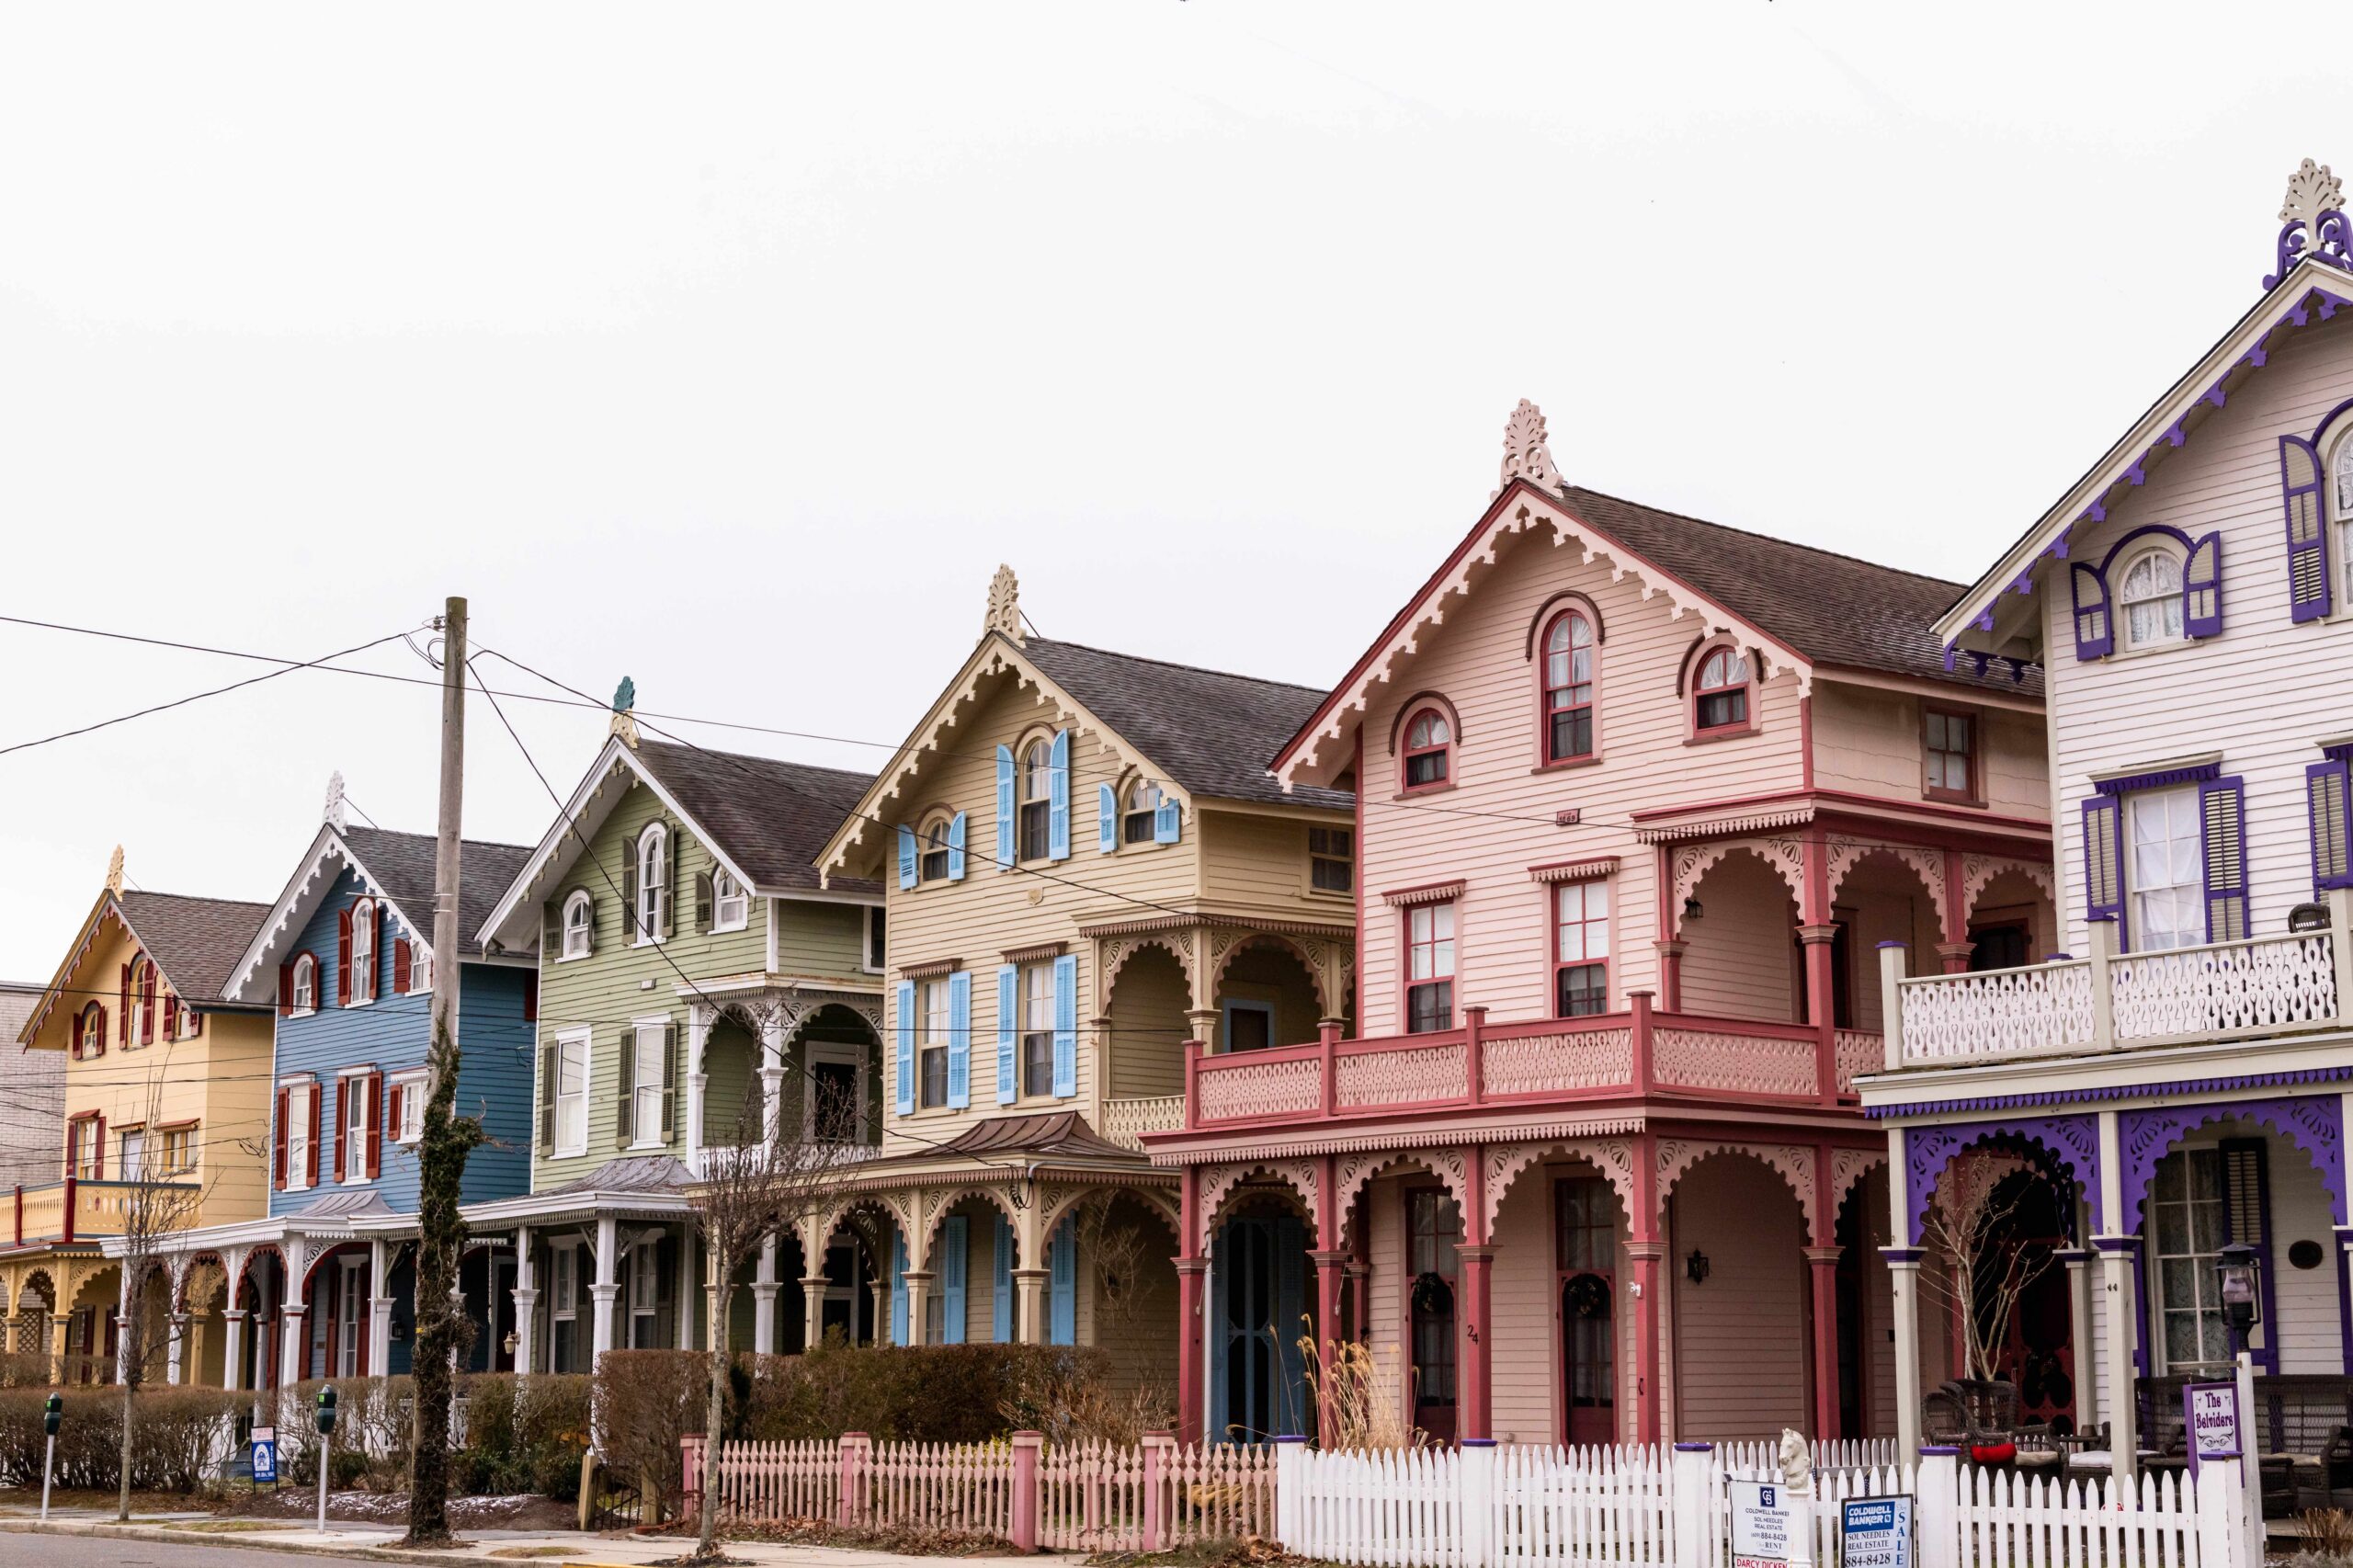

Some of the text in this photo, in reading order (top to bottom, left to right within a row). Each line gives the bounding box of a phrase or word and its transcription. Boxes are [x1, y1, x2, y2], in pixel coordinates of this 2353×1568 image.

[1467, 1324, 1478, 1345] 24
[2205, 1392, 2222, 1408] The
[2196, 1412, 2234, 1429] Belvidere
[1848, 1506, 1892, 1516] COLDWELL
[1848, 1515, 1883, 1526] BANKER
[1761, 1532, 1787, 1541] 884-8428
[1861, 1530, 1890, 1539] NEEDLES
[1765, 1541, 1782, 1550] RENT
[1864, 1540, 1889, 1549] ESTATE
[1736, 1559, 1759, 1568] DARCY
[1846, 1553, 1891, 1567] 884-8428
